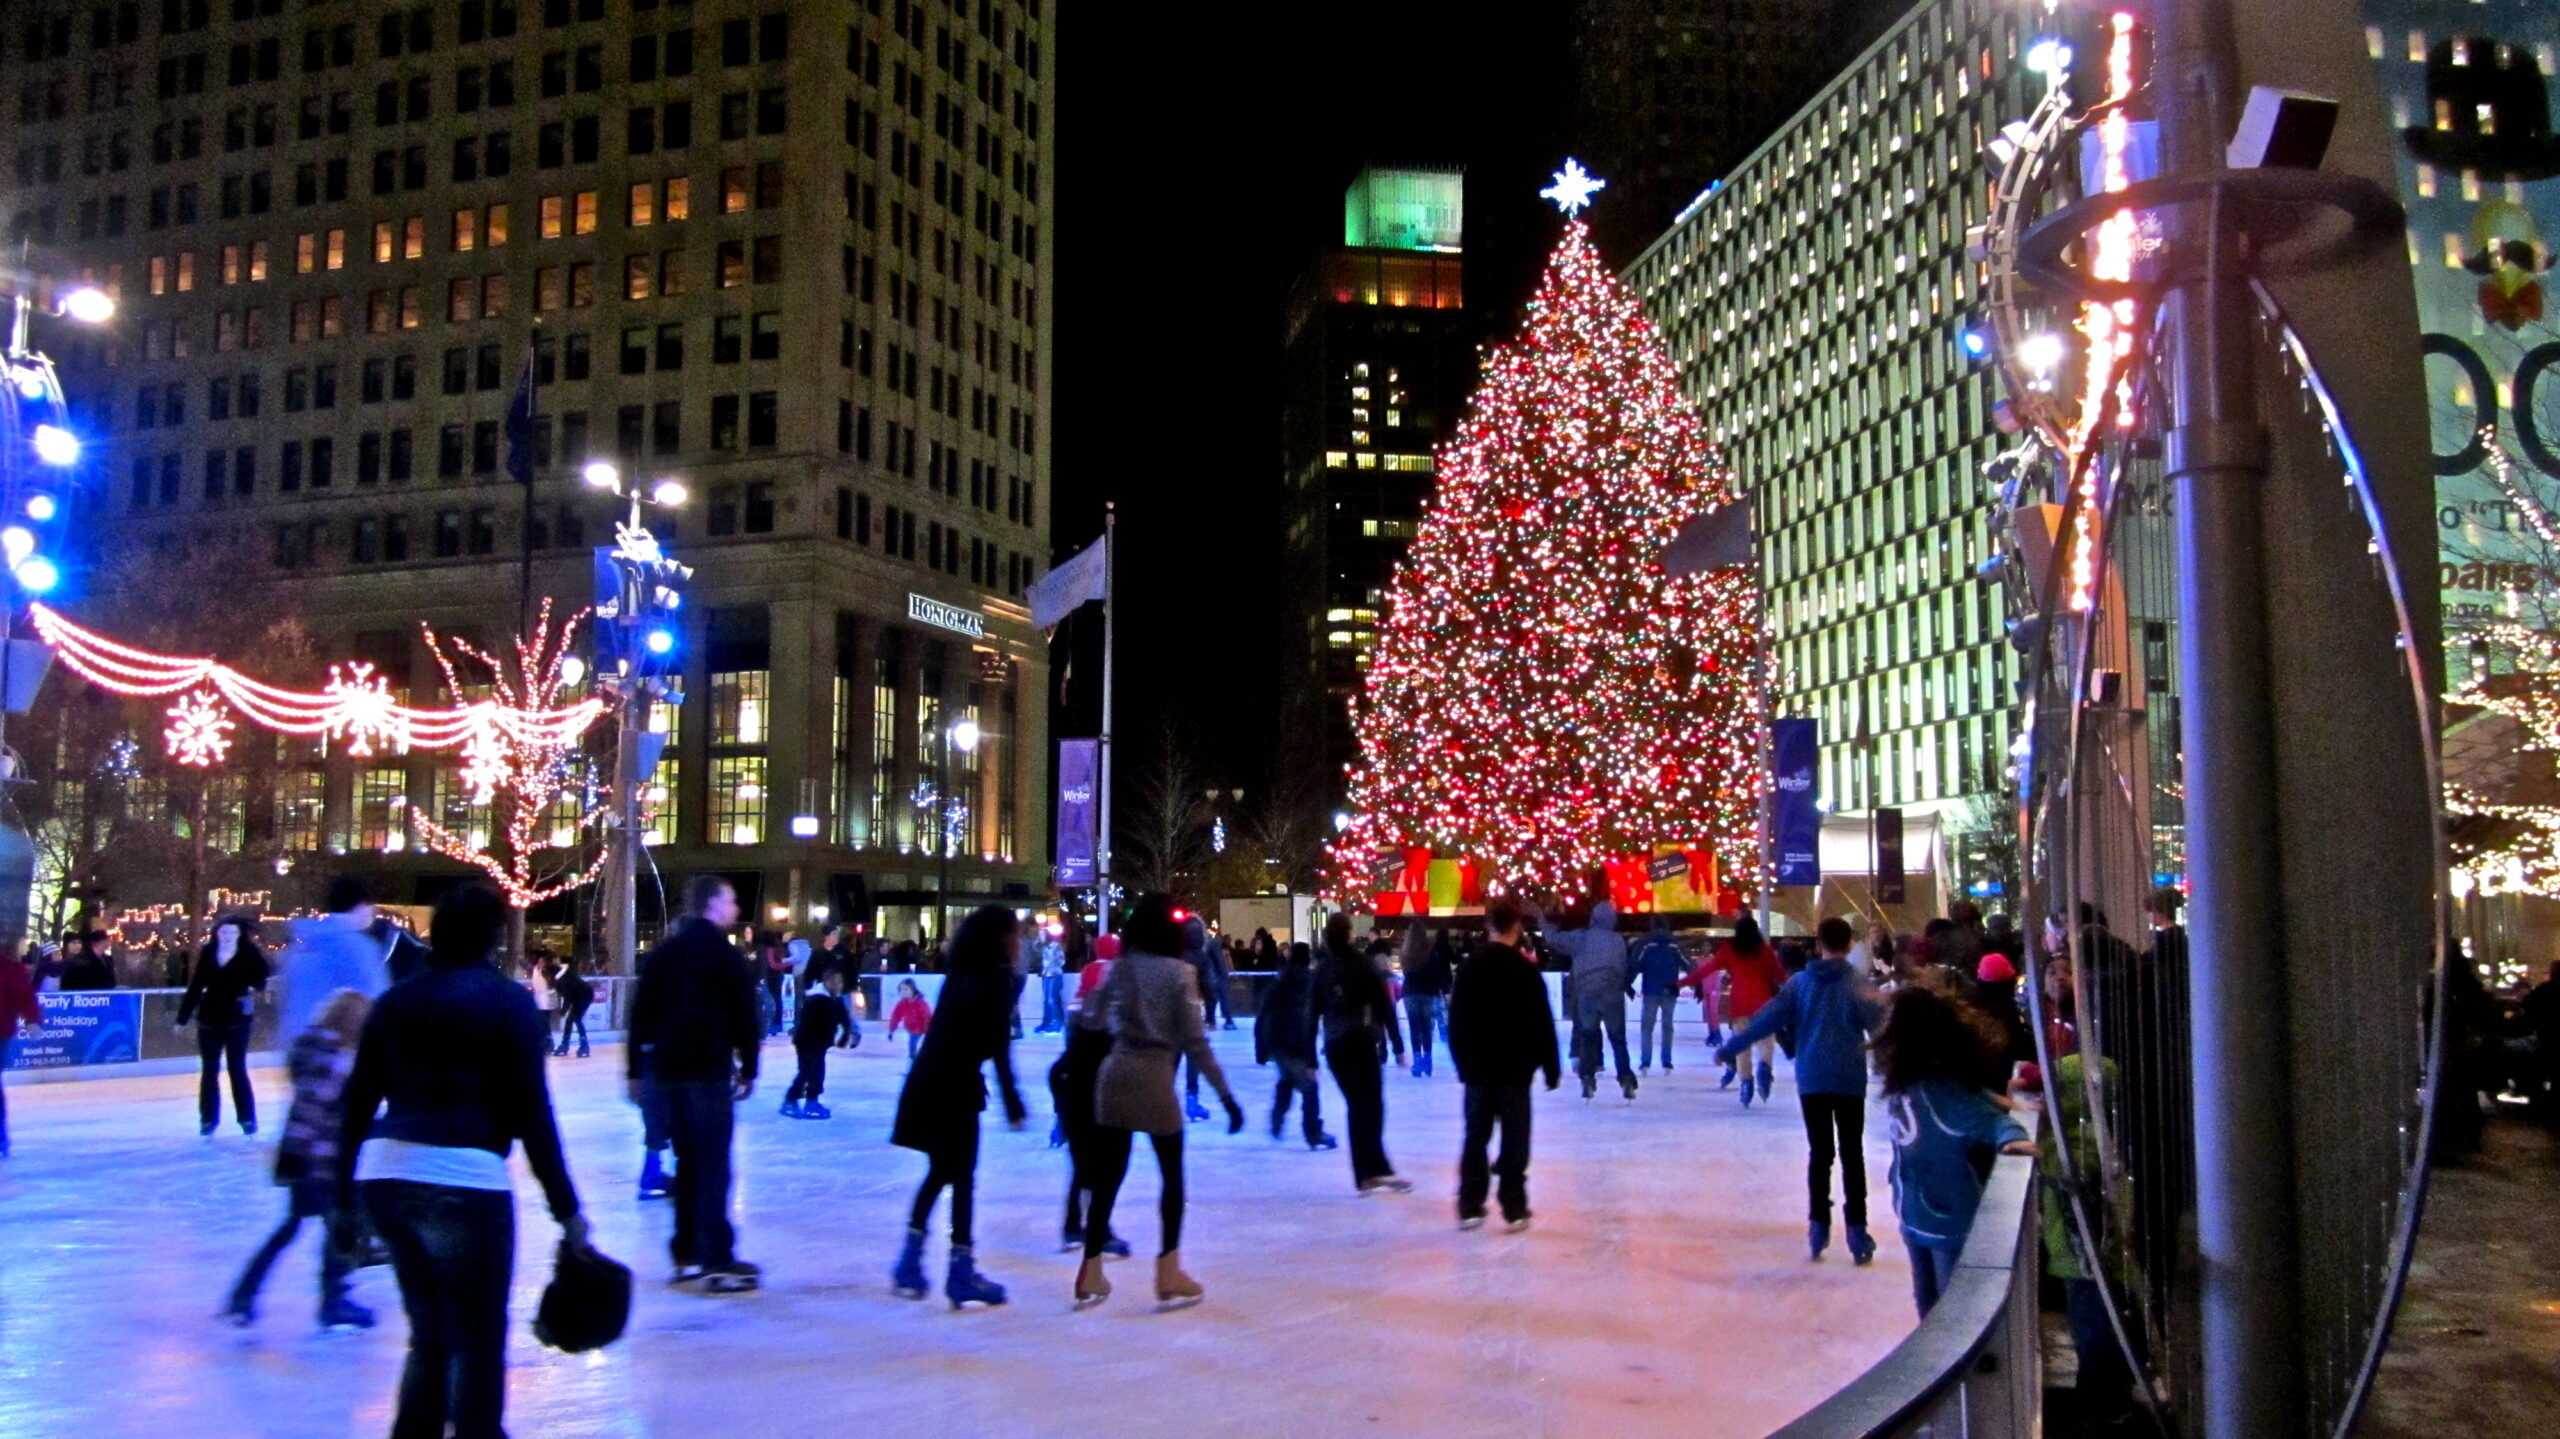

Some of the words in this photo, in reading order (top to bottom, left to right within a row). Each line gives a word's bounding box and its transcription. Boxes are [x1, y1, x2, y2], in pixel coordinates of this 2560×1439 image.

[909, 594, 984, 636] HONIGMAN
[1778, 777, 1810, 789] Winter
[1063, 790, 1091, 801] Winter
[38, 996, 70, 1009] Party
[74, 995, 110, 1007] Room
[53, 1016, 98, 1027] Holidays
[17, 1028, 74, 1040] Corate
[45, 1046, 64, 1054] Now
